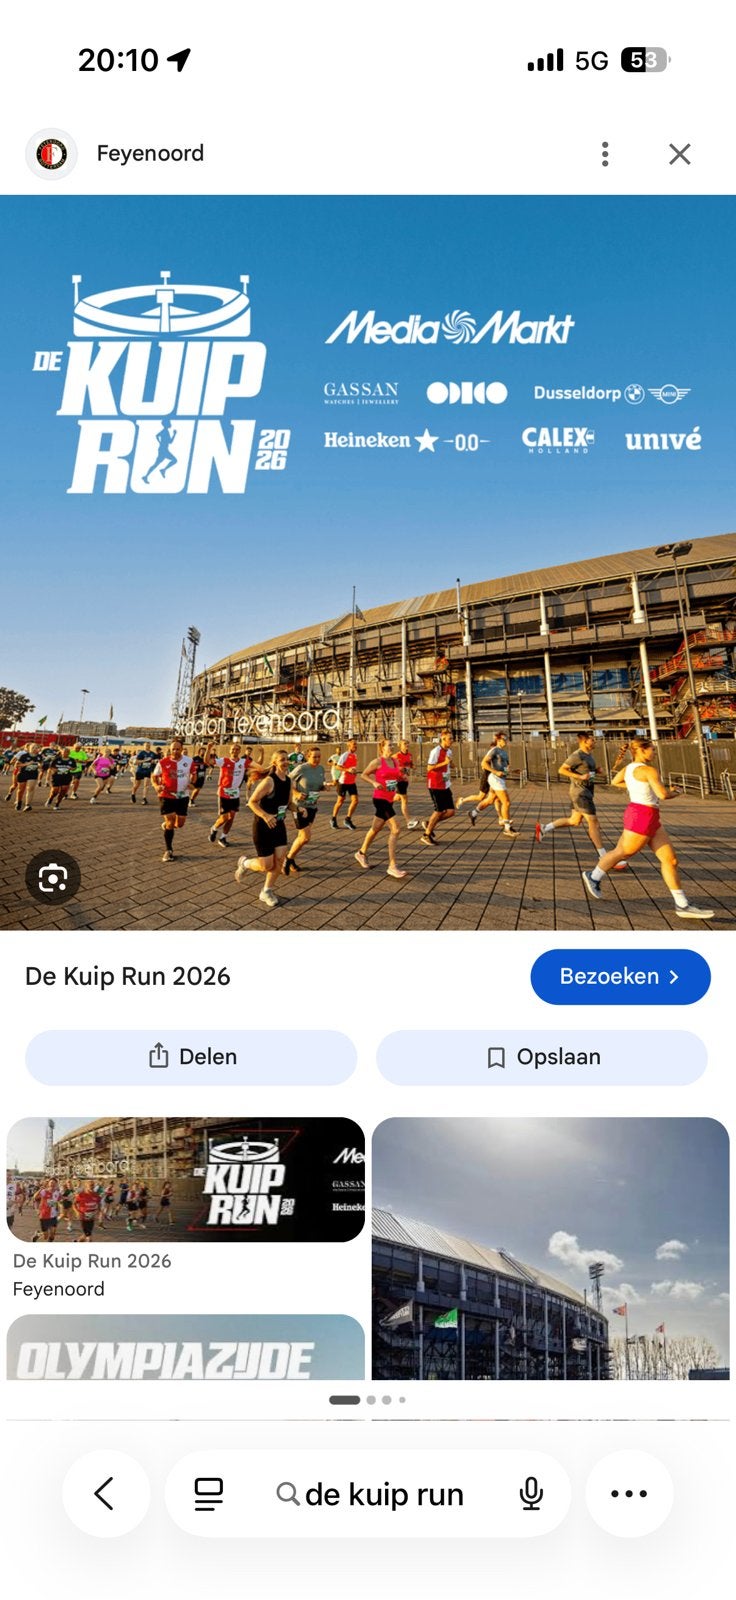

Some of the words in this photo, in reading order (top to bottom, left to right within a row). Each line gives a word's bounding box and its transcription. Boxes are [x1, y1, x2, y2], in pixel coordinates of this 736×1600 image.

[78, 47, 159, 73] 20:10
[575, 50, 609, 71] 5G
[630, 51, 658, 69] 53
[97, 143, 204, 166] Feyenoord
[325, 310, 441, 344] Media
[469, 310, 576, 344] Markt
[32, 351, 63, 371] DE
[56, 341, 267, 416] KUIP
[323, 382, 399, 397] GASSAN
[534, 386, 622, 402] Dusseldorp
[258, 429, 291, 450] 20
[323, 431, 411, 448] Heineken
[521, 427, 588, 447] CALEX
[625, 426, 702, 451] univé
[66, 419, 256, 494] RUN
[254, 450, 288, 470] 26
[174, 713, 226, 737] stadion
[26, 966, 57, 986] De
[64, 965, 115, 991] Kuip
[122, 966, 165, 986] Run
[173, 966, 231, 986] 2026
[560, 966, 660, 985] Bezoeken
[180, 1047, 237, 1066] Delen
[517, 1046, 601, 1070] Opslaan
[193, 1167, 205, 1177] DE
[202, 1164, 286, 1194] KUIP
[206, 1195, 282, 1225] RUN
[13, 1253, 37, 1269] De
[43, 1252, 82, 1272] Kuip
[88, 1253, 121, 1269] Run
[127, 1253, 172, 1269] 2026
[13, 1281, 105, 1301] Feyenoord
[305, 1481, 340, 1507] de
[349, 1481, 409, 1512] kuip
[417, 1487, 464, 1507] run
